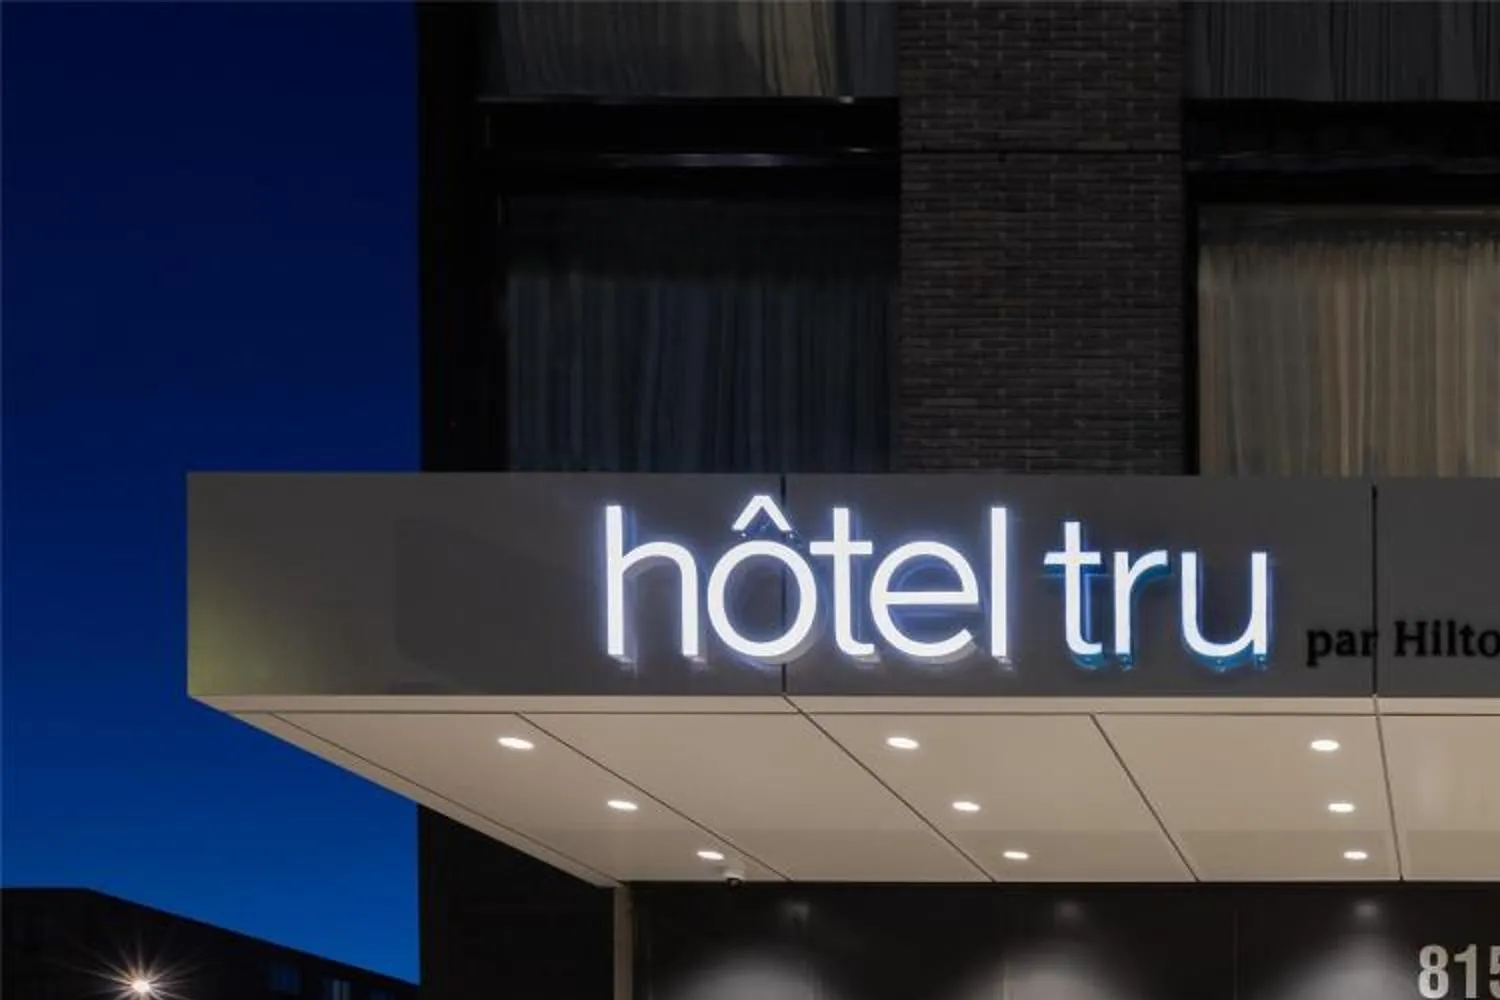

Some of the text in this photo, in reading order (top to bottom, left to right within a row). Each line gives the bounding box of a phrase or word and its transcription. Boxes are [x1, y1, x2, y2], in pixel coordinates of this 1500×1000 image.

[605, 495, 1008, 658] hôtel
[1043, 521, 1268, 657] tru
[1306, 629, 1378, 667] par
